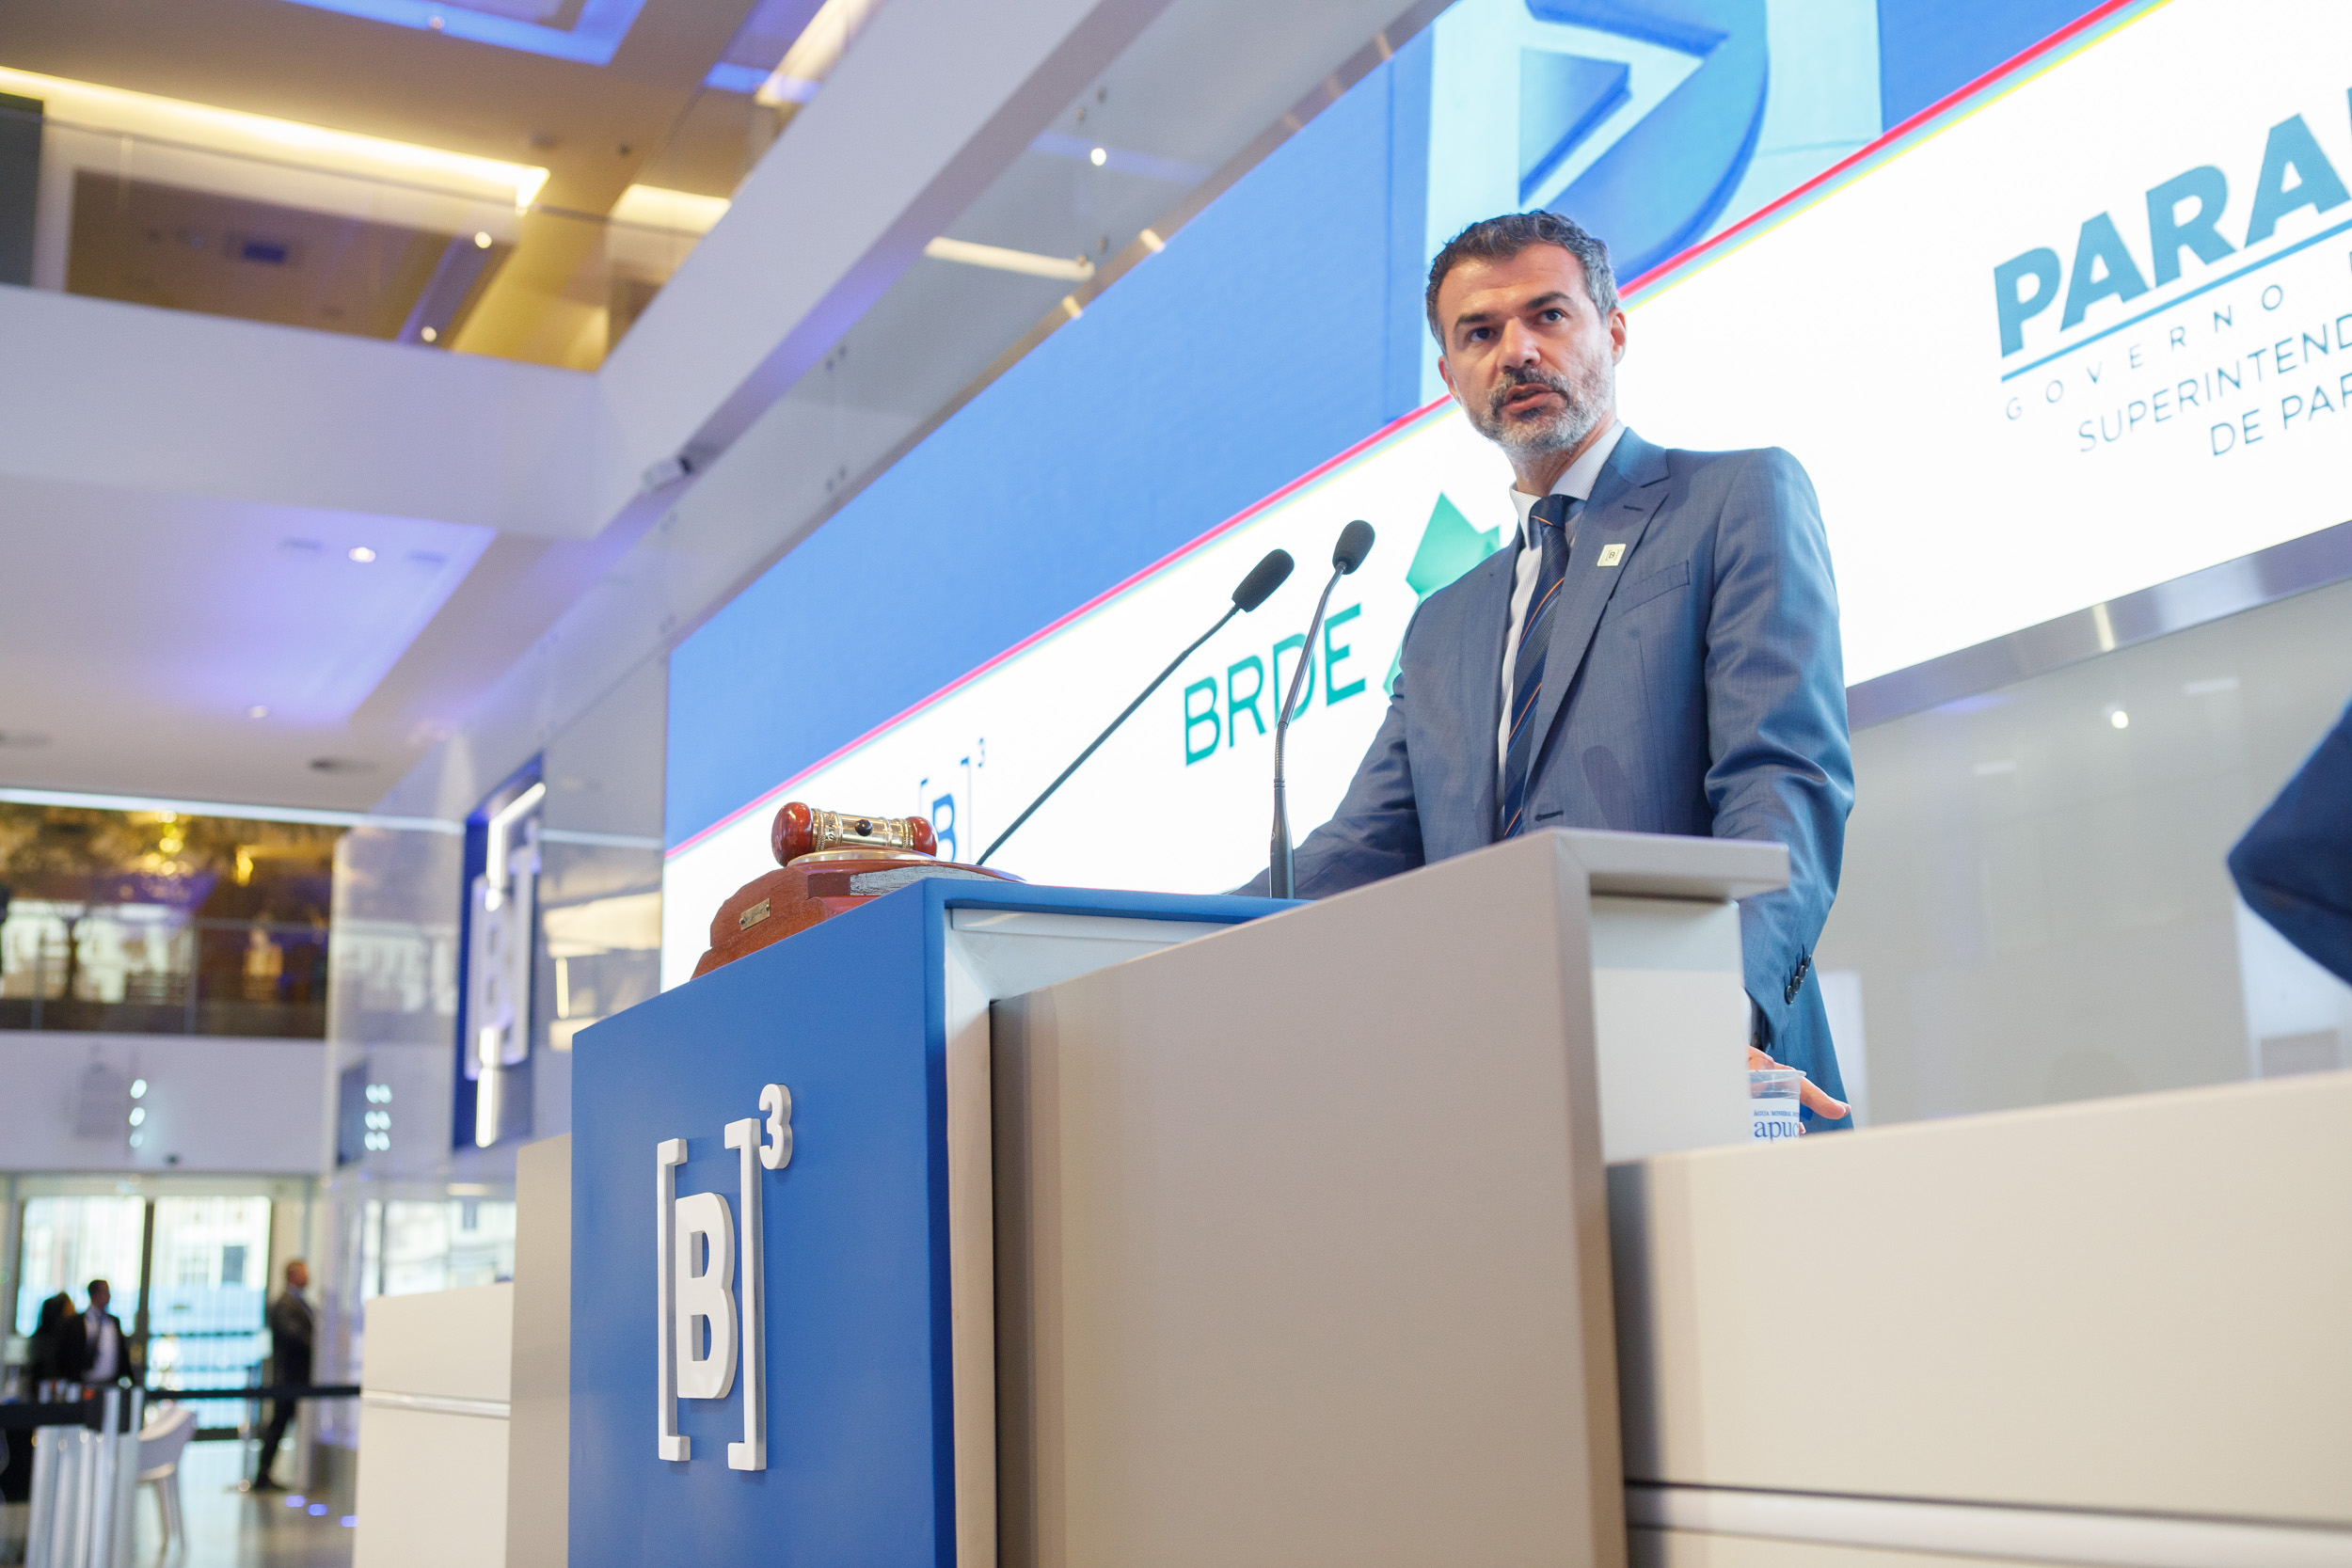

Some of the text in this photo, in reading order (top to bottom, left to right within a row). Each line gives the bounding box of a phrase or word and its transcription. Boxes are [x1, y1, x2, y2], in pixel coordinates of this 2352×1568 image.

[1994, 87, 2352, 358] PARA
[2006, 285, 2283, 420] GOVERNO
[2211, 409, 2264, 456] DE
[1184, 603, 1367, 767] BRDE
